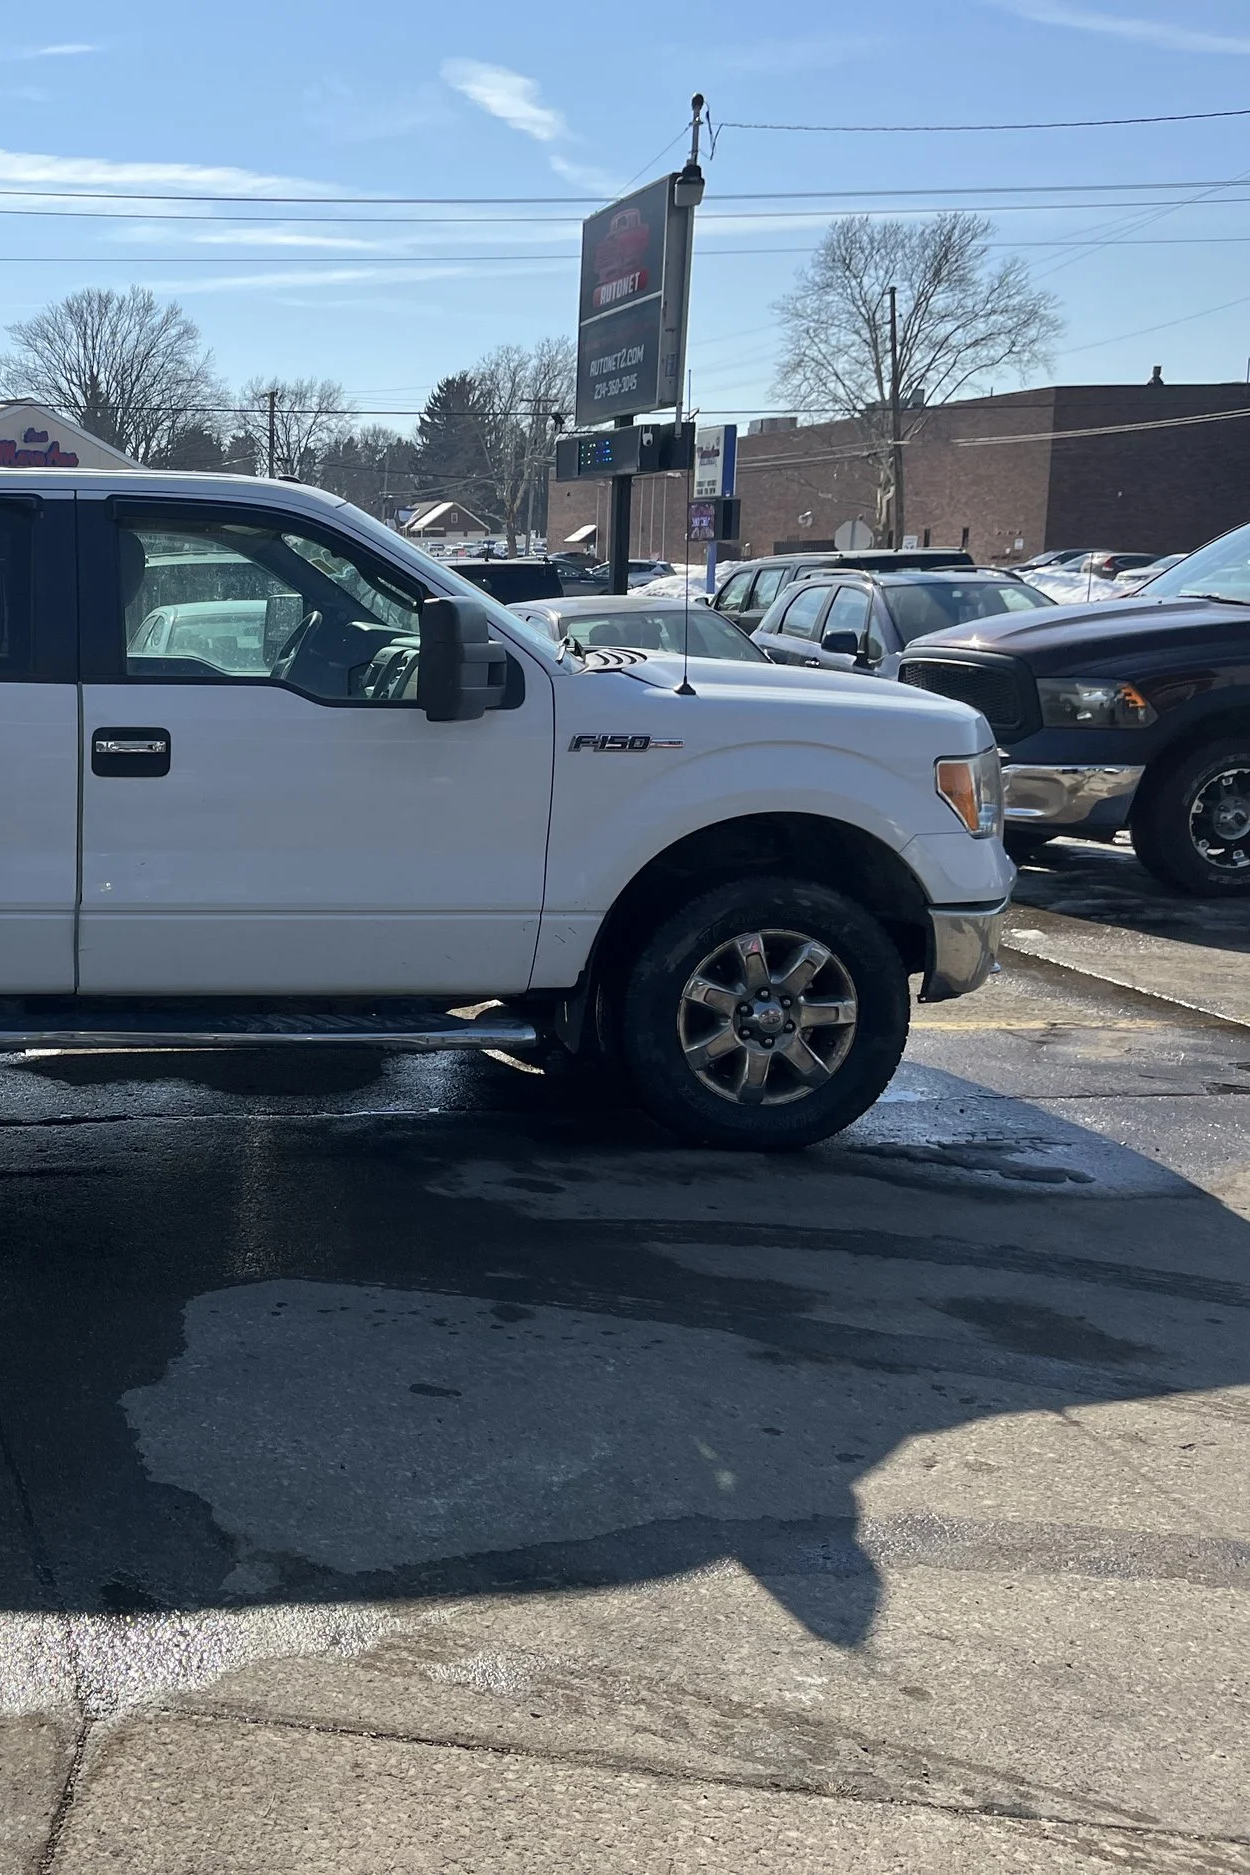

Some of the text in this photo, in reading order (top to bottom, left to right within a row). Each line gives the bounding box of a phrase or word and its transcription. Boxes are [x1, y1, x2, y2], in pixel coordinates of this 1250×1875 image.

[599, 272, 640, 305] AUTONET
[590, 344, 644, 377] AUTONET2.COM
[568, 735, 652, 752] F-150
